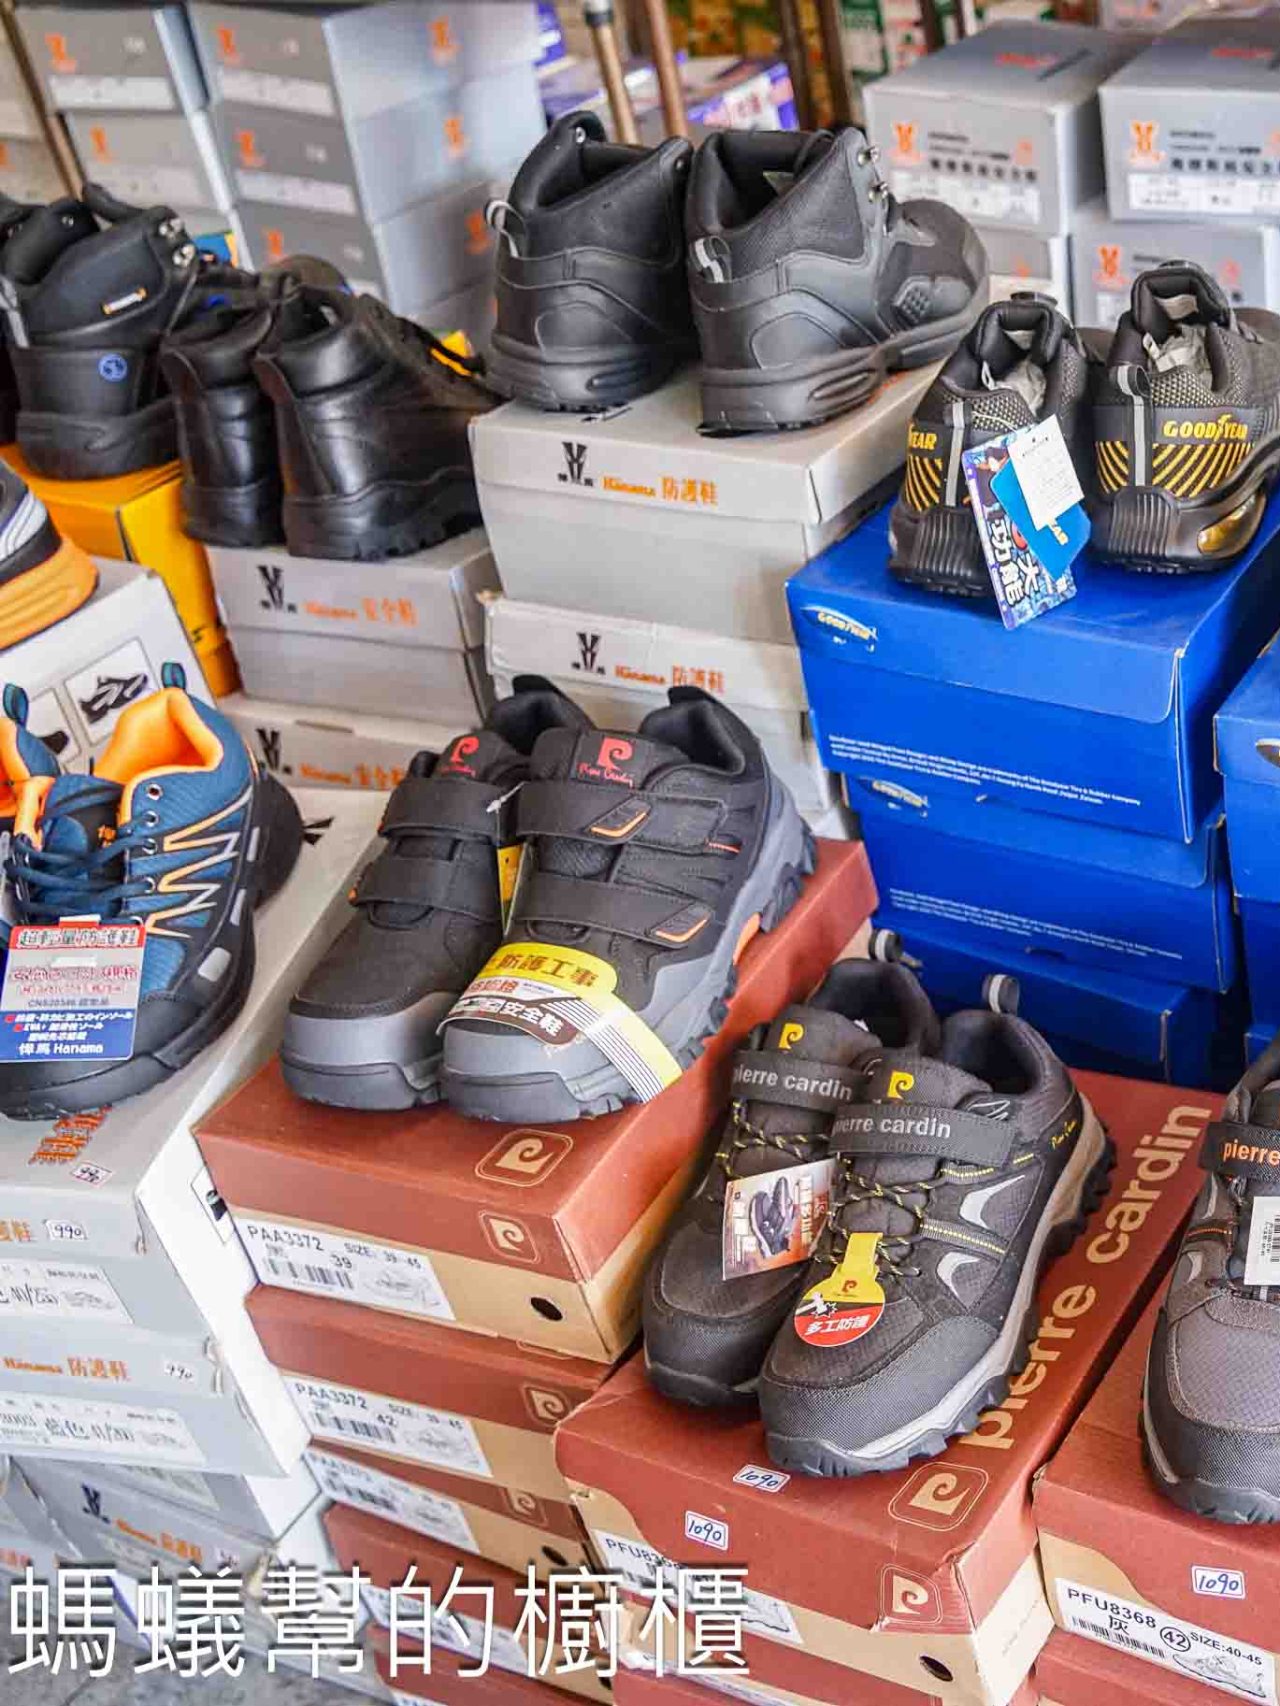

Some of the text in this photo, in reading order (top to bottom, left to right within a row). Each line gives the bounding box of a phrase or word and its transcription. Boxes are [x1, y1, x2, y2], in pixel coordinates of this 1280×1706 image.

[1163, 411, 1248, 441] GOODYEAR
[783, 1074, 852, 1101] cardin
[879, 1117, 952, 1140] cardin
[1222, 1139, 1280, 1168] pierre
[54, 1224, 82, 1239] 990
[247, 1225, 325, 1252] PAA3372
[330, 1254, 353, 1269] 39
[958, 1104, 1211, 1449] pierre cardin
[804, 1313, 871, 1336] 多工防護
[295, 1383, 368, 1410] PAA3372
[740, 1470, 779, 1488] 1090
[689, 1520, 722, 1542] 1090
[1199, 1573, 1240, 1594] 1090
[1066, 1587, 1264, 1666] PFU8368 42 SIZE:40-45
[1107, 1615, 1131, 1636] 灰
